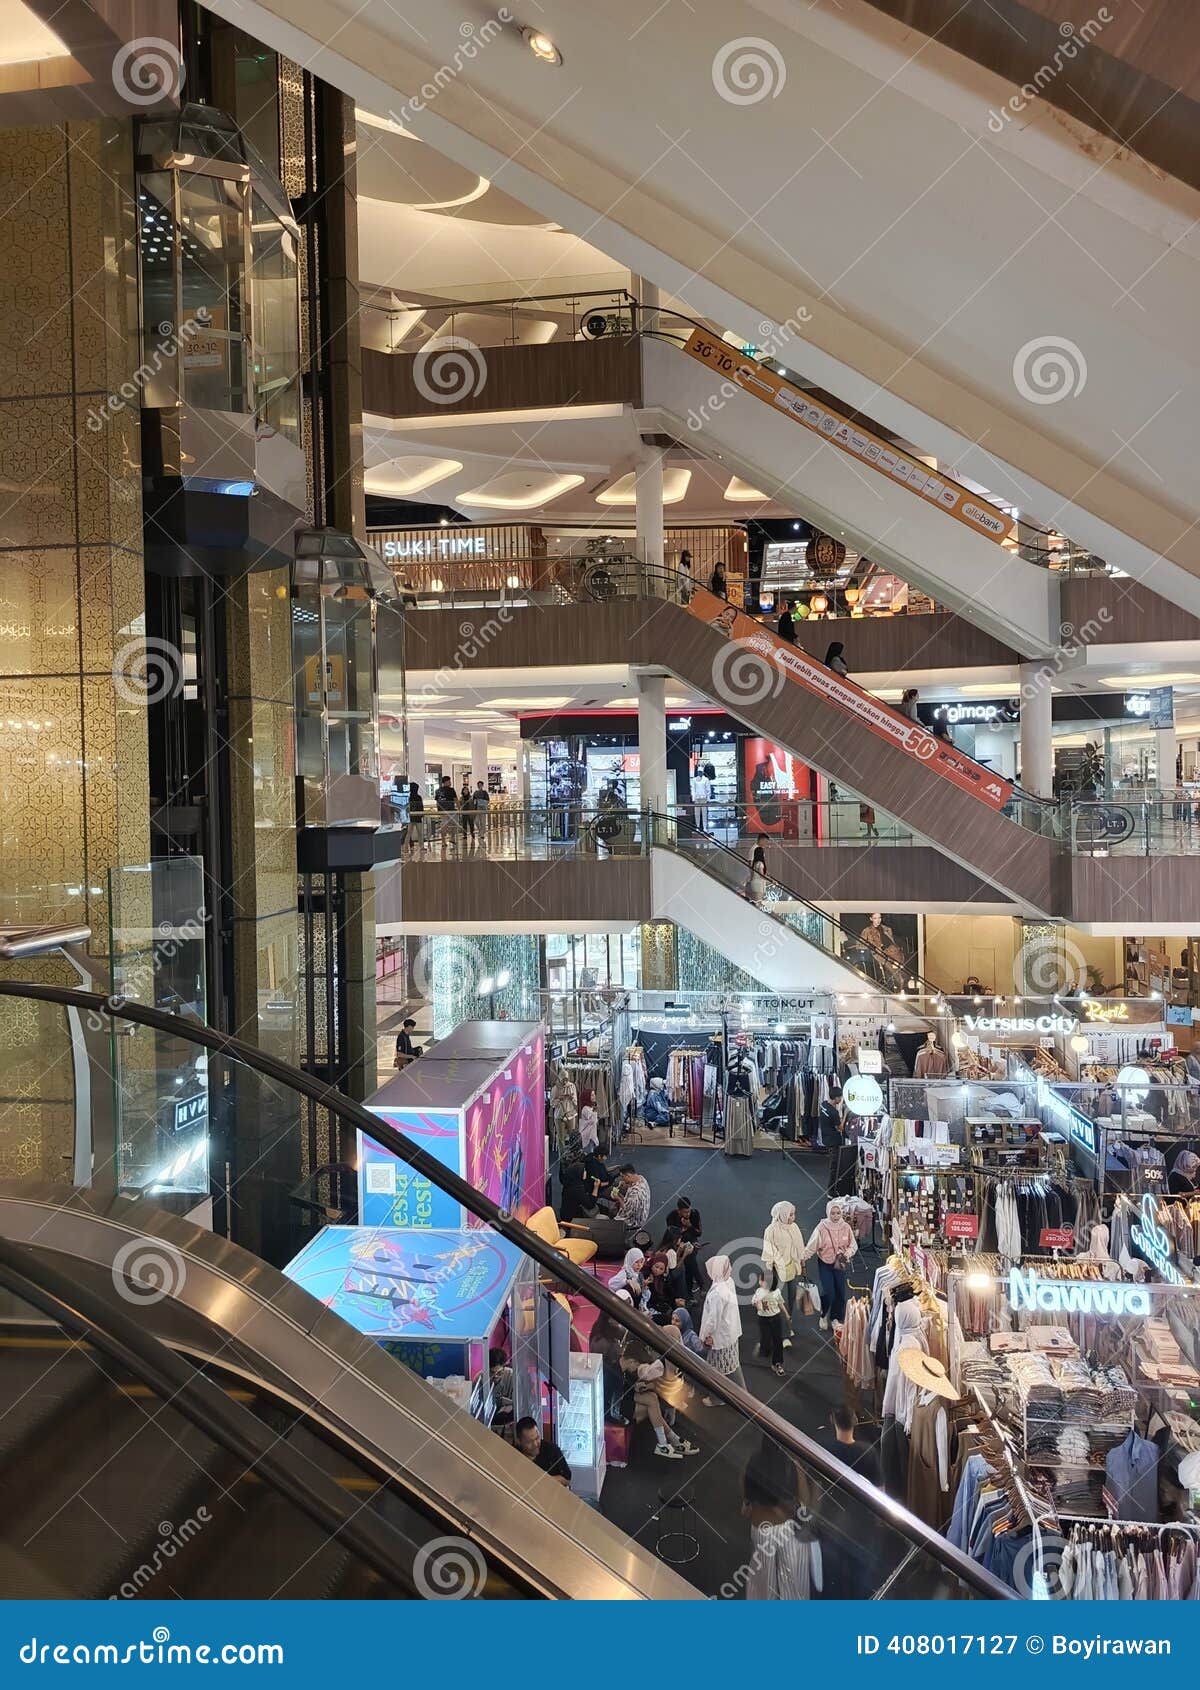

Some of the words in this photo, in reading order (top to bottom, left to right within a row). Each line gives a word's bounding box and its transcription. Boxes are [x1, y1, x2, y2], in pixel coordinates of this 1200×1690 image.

[965, 505, 1000, 532] allobank
[385, 540, 432, 557] SUKI
[438, 537, 486, 555] TIME
[794, 660, 812, 677] lebih
[812, 672, 830, 688] puas
[830, 682, 856, 705] dengan
[856, 699, 880, 721] diskon
[880, 716, 905, 737] hingga
[760, 781, 776, 790] EASY
[755, 999, 815, 1009] TTONCUT
[964, 1014, 1036, 1032] Versus
[1036, 1013, 1079, 1035] City
[1144, 1169, 1164, 1180] 50%
[411, 1179, 432, 1229] Fest
[1009, 1267, 1151, 1316] Nawwa
